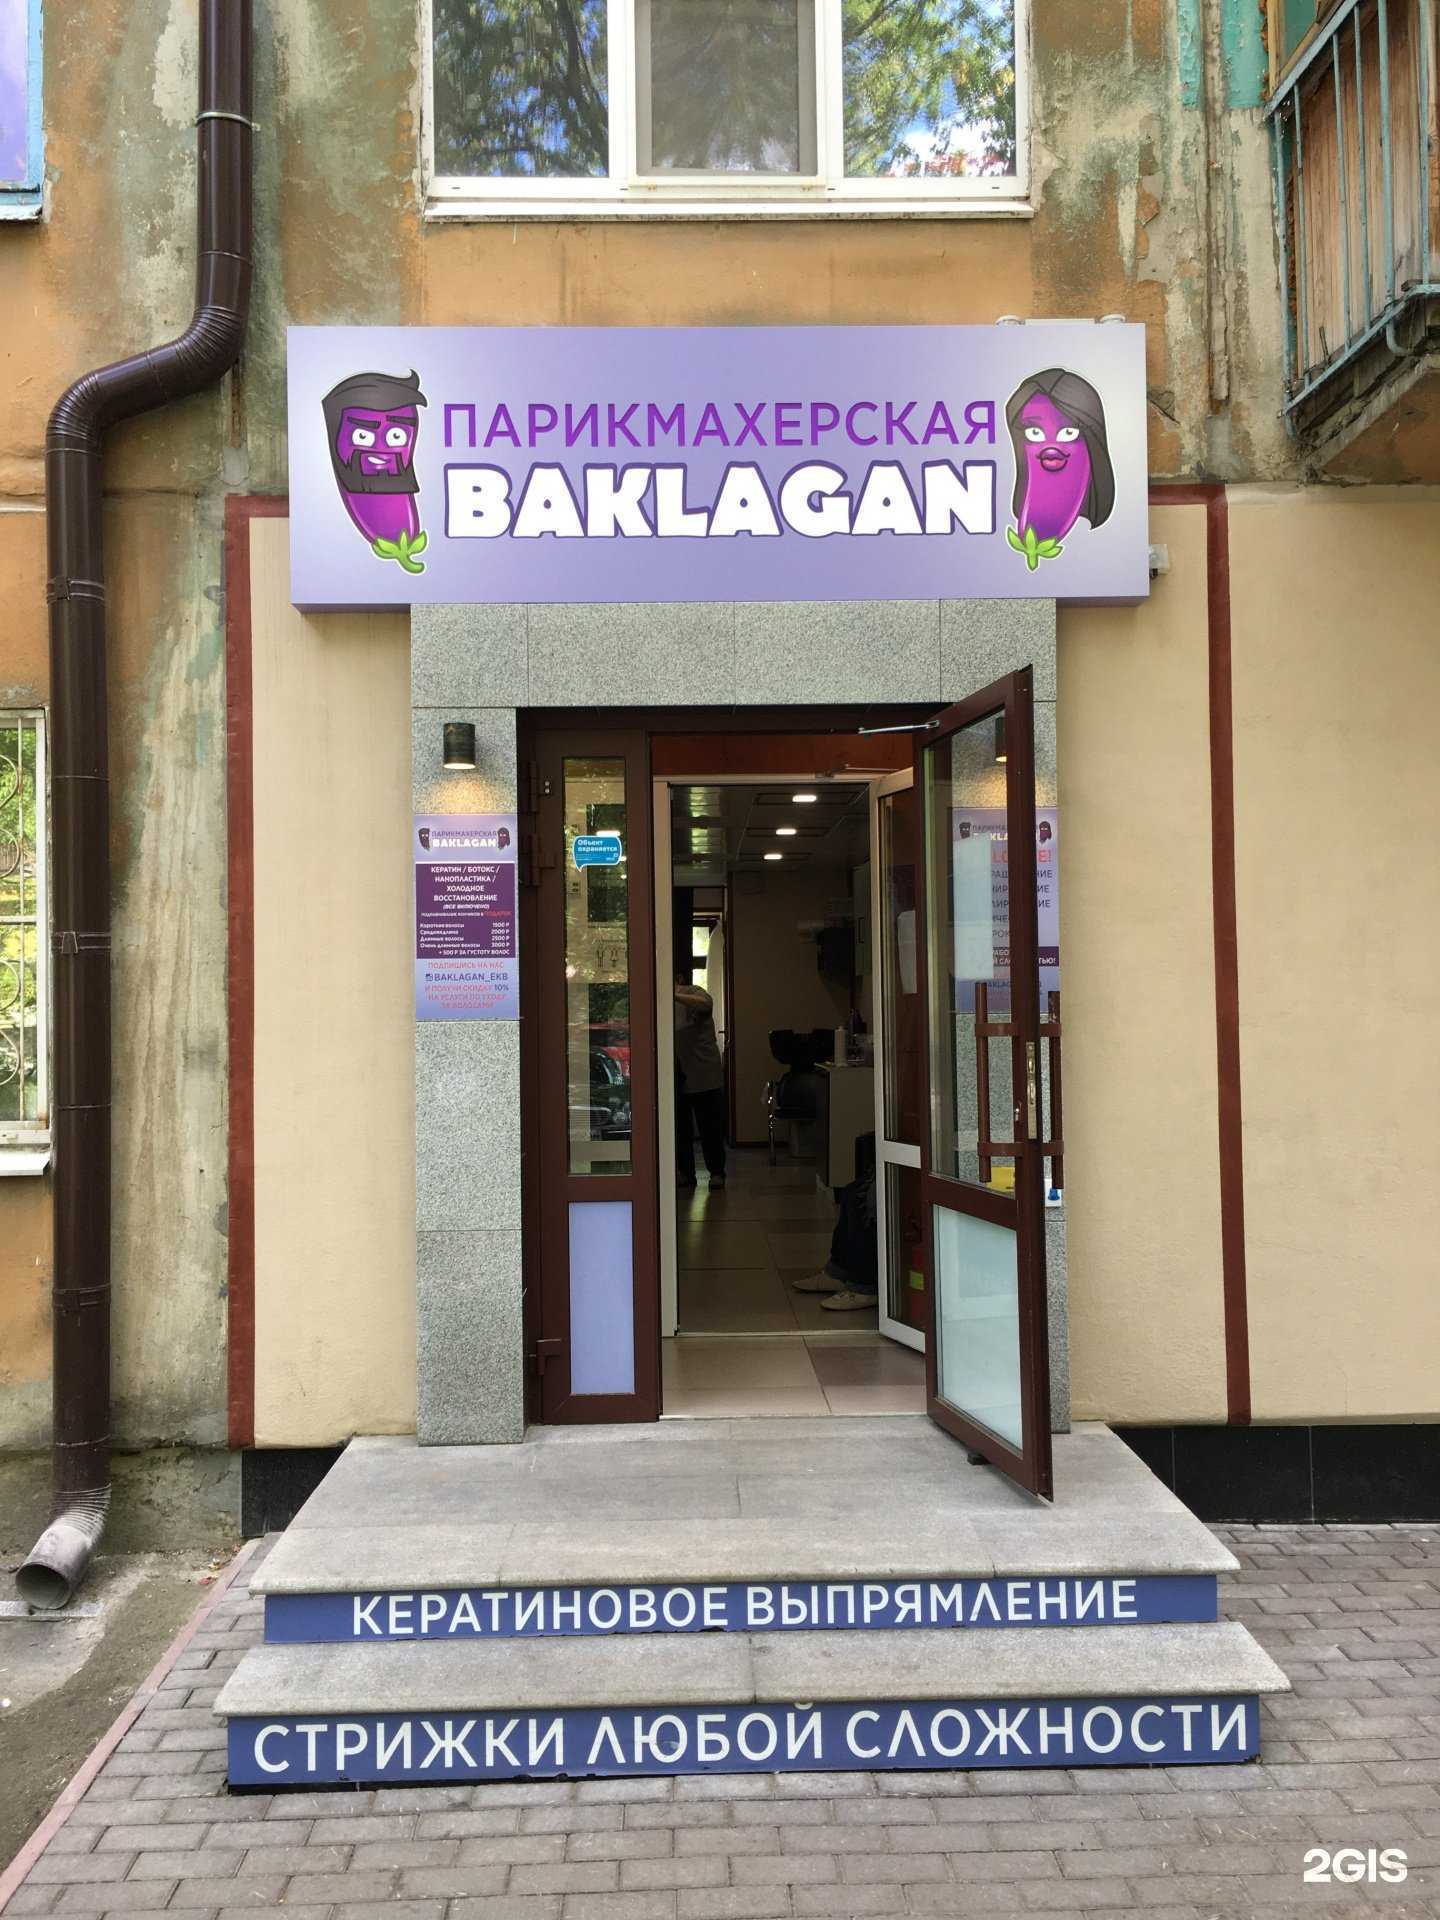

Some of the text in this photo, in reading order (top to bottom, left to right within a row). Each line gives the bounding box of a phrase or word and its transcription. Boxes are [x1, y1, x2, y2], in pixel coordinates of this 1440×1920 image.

[444, 400, 996, 448] ПАРИКМАХЕРСКАЯ
[443, 460, 997, 538] BAKLAGAN
[432, 838, 497, 848] BAKLAGAN
[434, 875, 491, 883] НАНОПЛАСТИКА
[433, 894, 498, 902] ВОССТАНОВЛЕНИЕ
[434, 972, 509, 982] BAKLAGAN_EKB
[352, 1580, 1139, 1636] КЕРАТИНОВОЕ ВЫПРЯМЛЕНИЕ
[253, 1703, 1248, 1774] СТРИЖКИ ЛЮБОЙ СЛОЖНОСТИ
